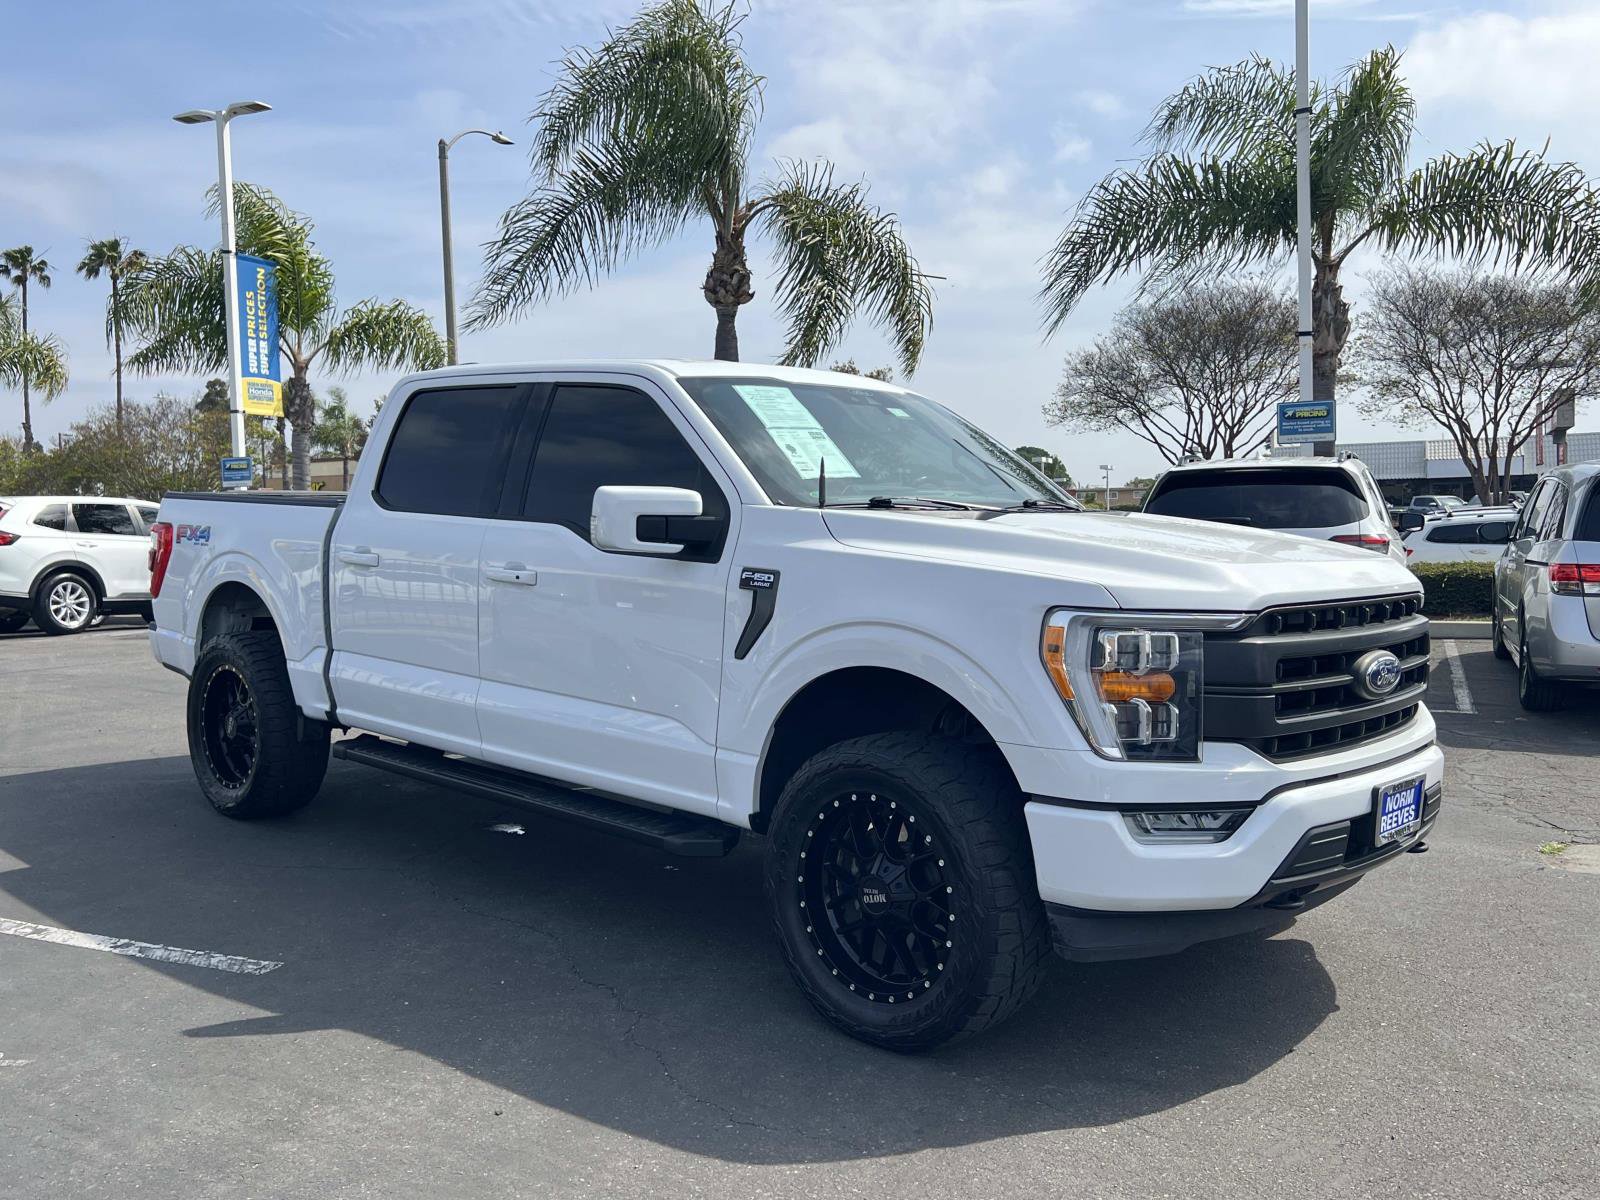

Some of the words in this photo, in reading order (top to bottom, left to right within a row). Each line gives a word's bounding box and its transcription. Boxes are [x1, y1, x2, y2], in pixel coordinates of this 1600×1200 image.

[246, 291, 256, 337] PRICES
[257, 267, 267, 339] SELECTION
[247, 338, 258, 374] SUPER
[259, 340, 270, 375] SUPER
[249, 387, 272, 396] Honda
[1296, 410, 1328, 418] PRICING
[176, 524, 211, 544] FX4
[742, 571, 774, 582] F-150
[1385, 788, 1415, 814] NORM
[1380, 804, 1416, 833] REEVES
[863, 894, 887, 903] MOTO
